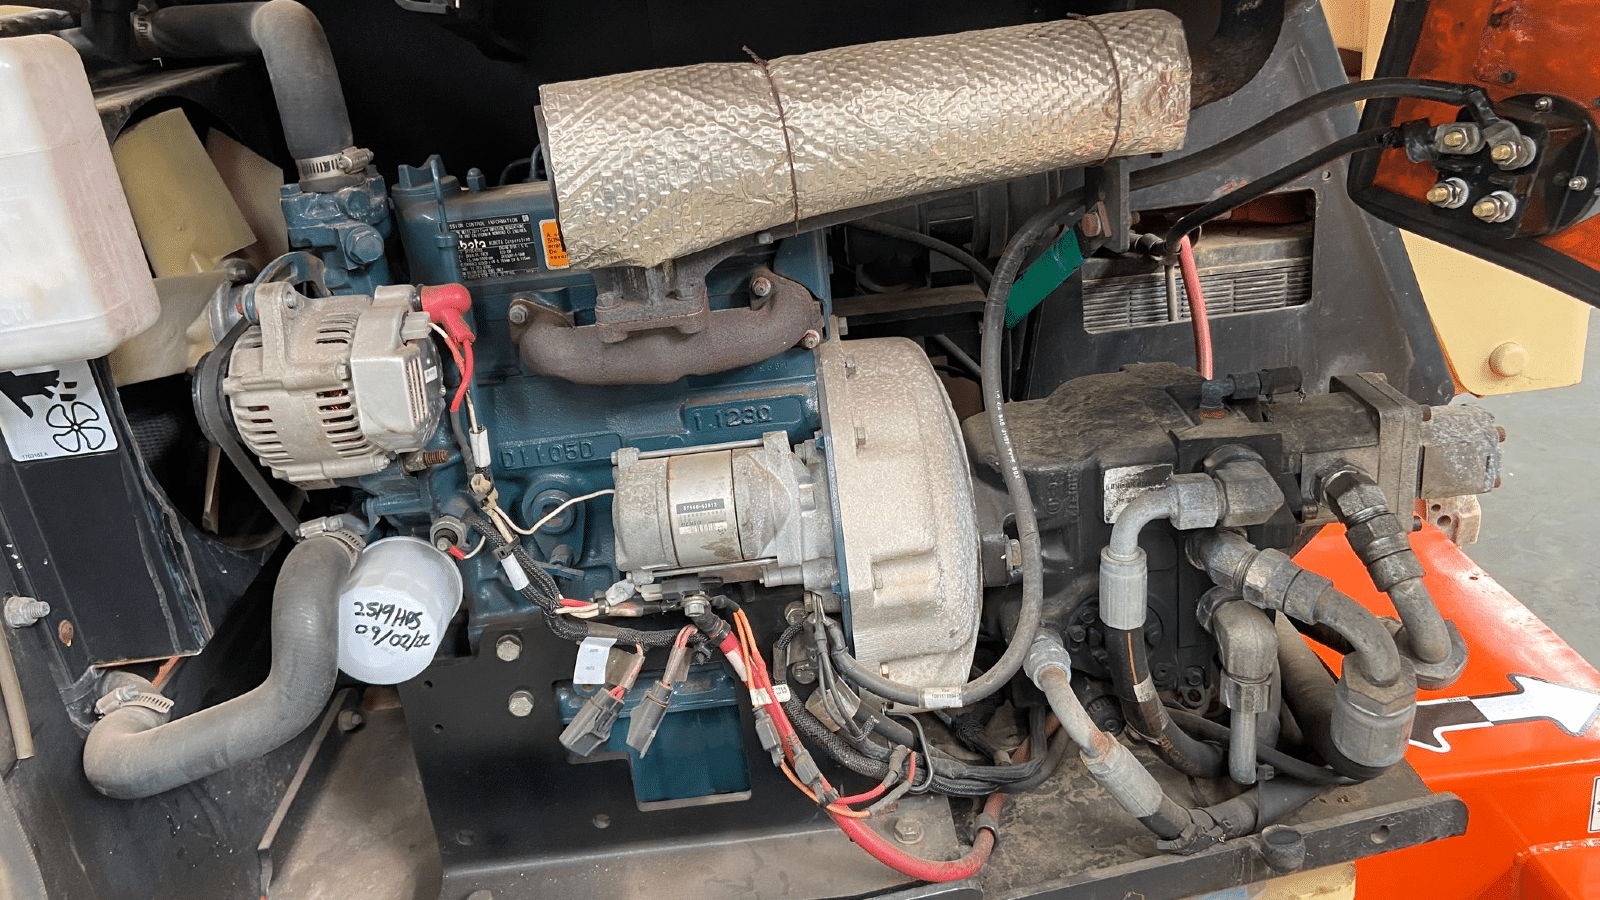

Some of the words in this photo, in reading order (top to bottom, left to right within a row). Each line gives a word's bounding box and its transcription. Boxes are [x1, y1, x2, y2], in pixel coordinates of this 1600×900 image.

[465, 220, 485, 228] CONTROL
[487, 217, 518, 225] INFORMATION
[459, 238, 487, 250] bota
[499, 440, 594, 470] D1105D
